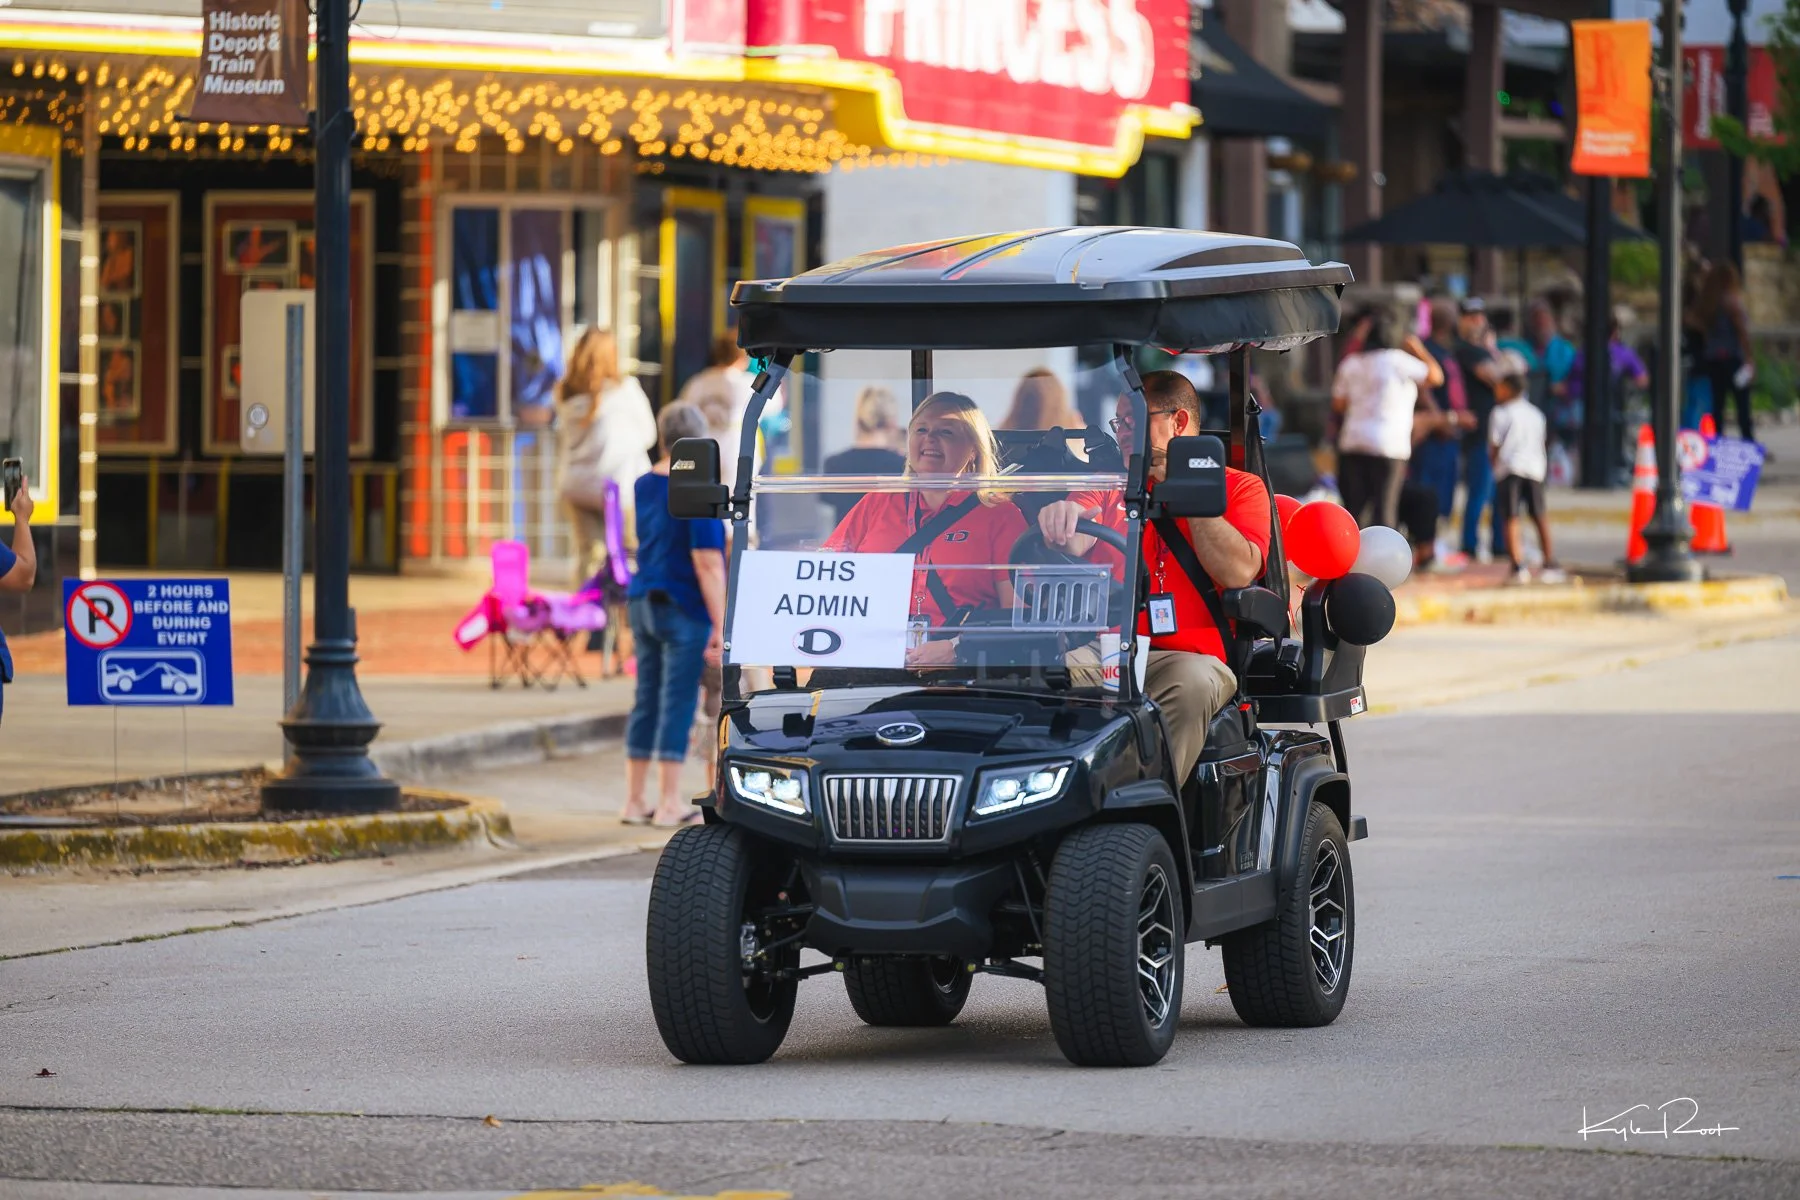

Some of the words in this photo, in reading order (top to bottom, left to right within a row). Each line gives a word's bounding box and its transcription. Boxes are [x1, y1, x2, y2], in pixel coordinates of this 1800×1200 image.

[209, 11, 281, 31] Historic
[208, 33, 265, 55] Depot
[267, 32, 281, 51] &
[207, 54, 256, 73] Train
[203, 74, 285, 94] Museum
[796, 560, 856, 582] DHS
[147, 585, 157, 598] 2
[160, 585, 213, 598] HOURS
[133, 601, 193, 614] BEFORE
[197, 601, 229, 614] AND
[774, 594, 869, 617] ADMIN
[152, 616, 212, 630] DURING
[157, 632, 208, 645] EVENT
[797, 628, 842, 656] D
